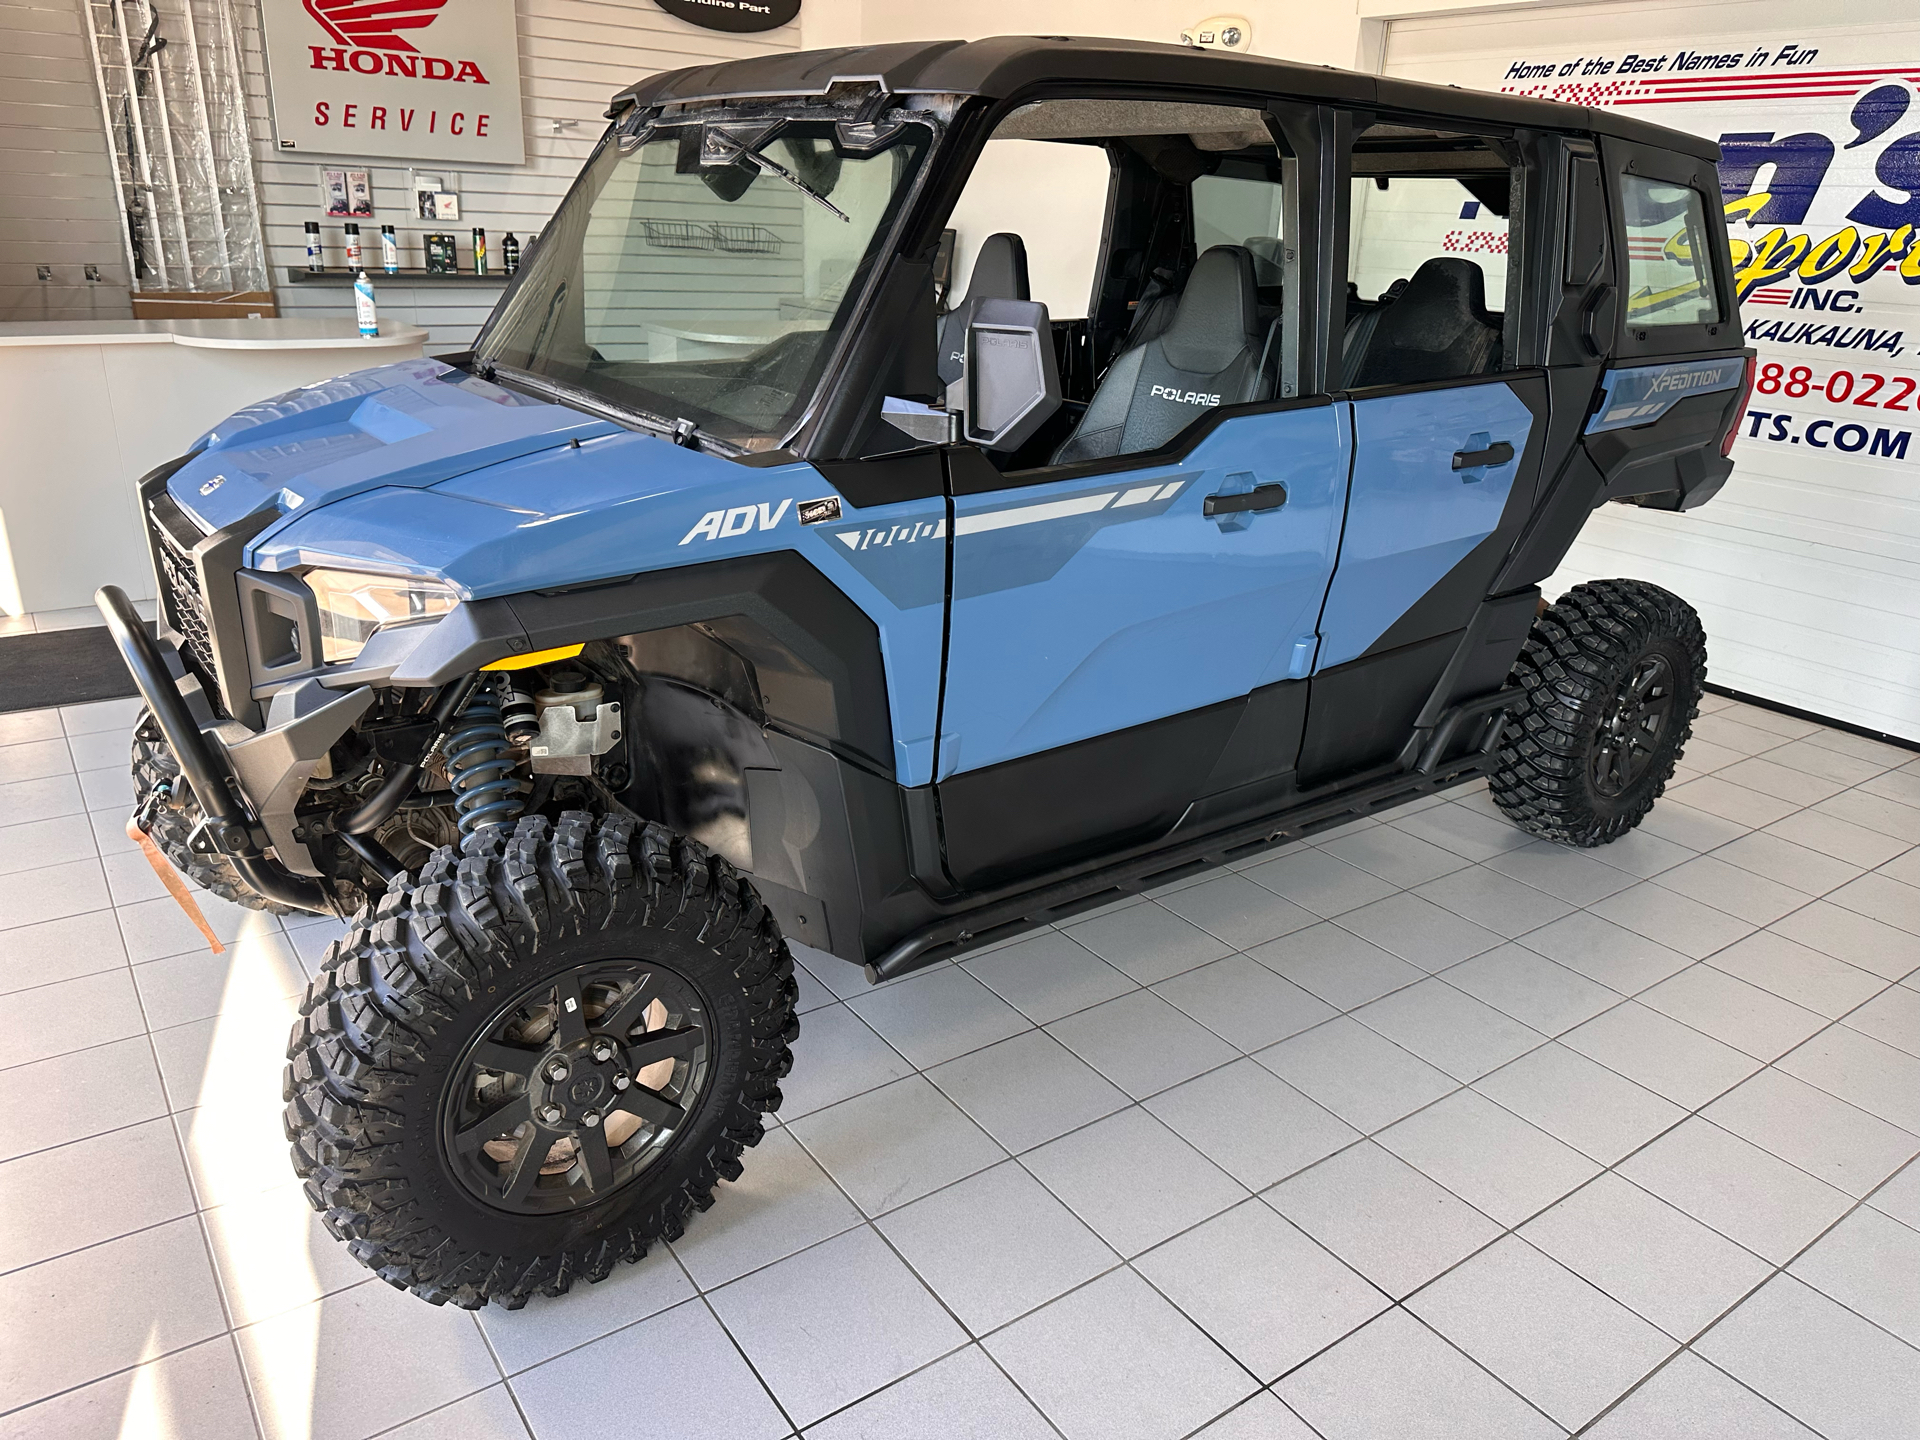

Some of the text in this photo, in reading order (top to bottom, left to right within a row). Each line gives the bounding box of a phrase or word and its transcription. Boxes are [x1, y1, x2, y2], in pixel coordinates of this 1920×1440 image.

[308, 45, 490, 85] HONDA
[1504, 44, 1820, 80] Home of the Best Names in Fun
[314, 101, 490, 137] SERVICE
[1789, 287, 1863, 314] INC.
[1743, 318, 1905, 358] KAUKAUNA,
[1150, 384, 1221, 407] POLARIS
[1643, 368, 1722, 400] XPEDITION
[1756, 363, 1920, 412] 88-022
[1747, 410, 1912, 460] TS.COM
[678, 498, 793, 546] ADV
[419, 732, 446, 768] POLARIS
